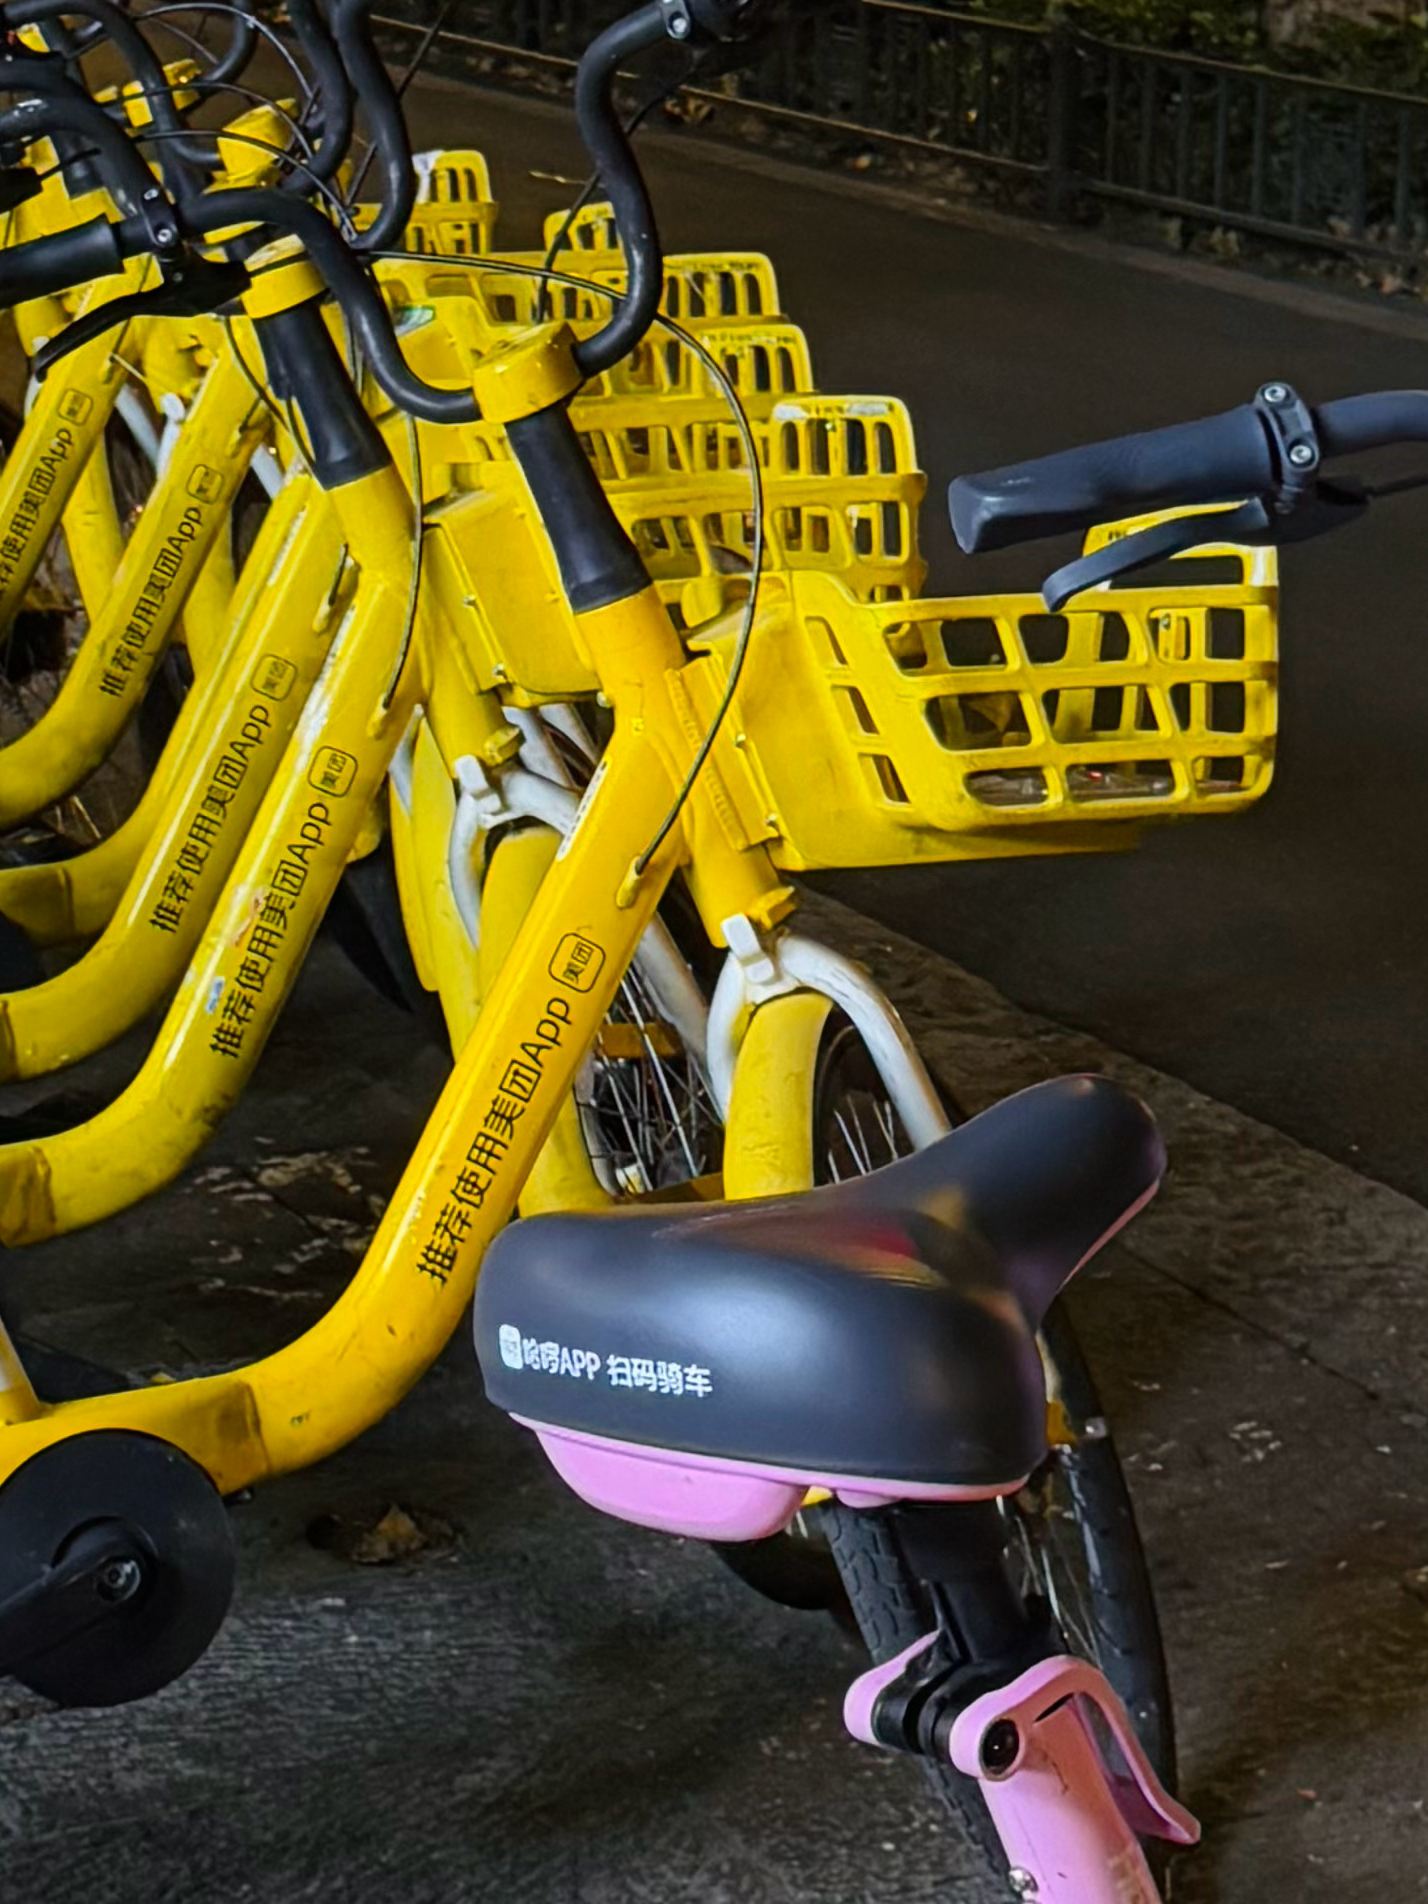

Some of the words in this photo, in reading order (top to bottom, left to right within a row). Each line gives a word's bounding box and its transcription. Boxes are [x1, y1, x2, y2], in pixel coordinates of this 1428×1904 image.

[99, 505, 203, 699] 推荐使用美团App
[150, 702, 272, 934] 推荐使用美团App
[209, 800, 331, 1060] 推荐使用美团App
[417, 995, 572, 1288] 推荐使用美团App
[521, 1337, 601, 1380] 哈啰APP
[605, 1353, 714, 1398] 扫码骑车
